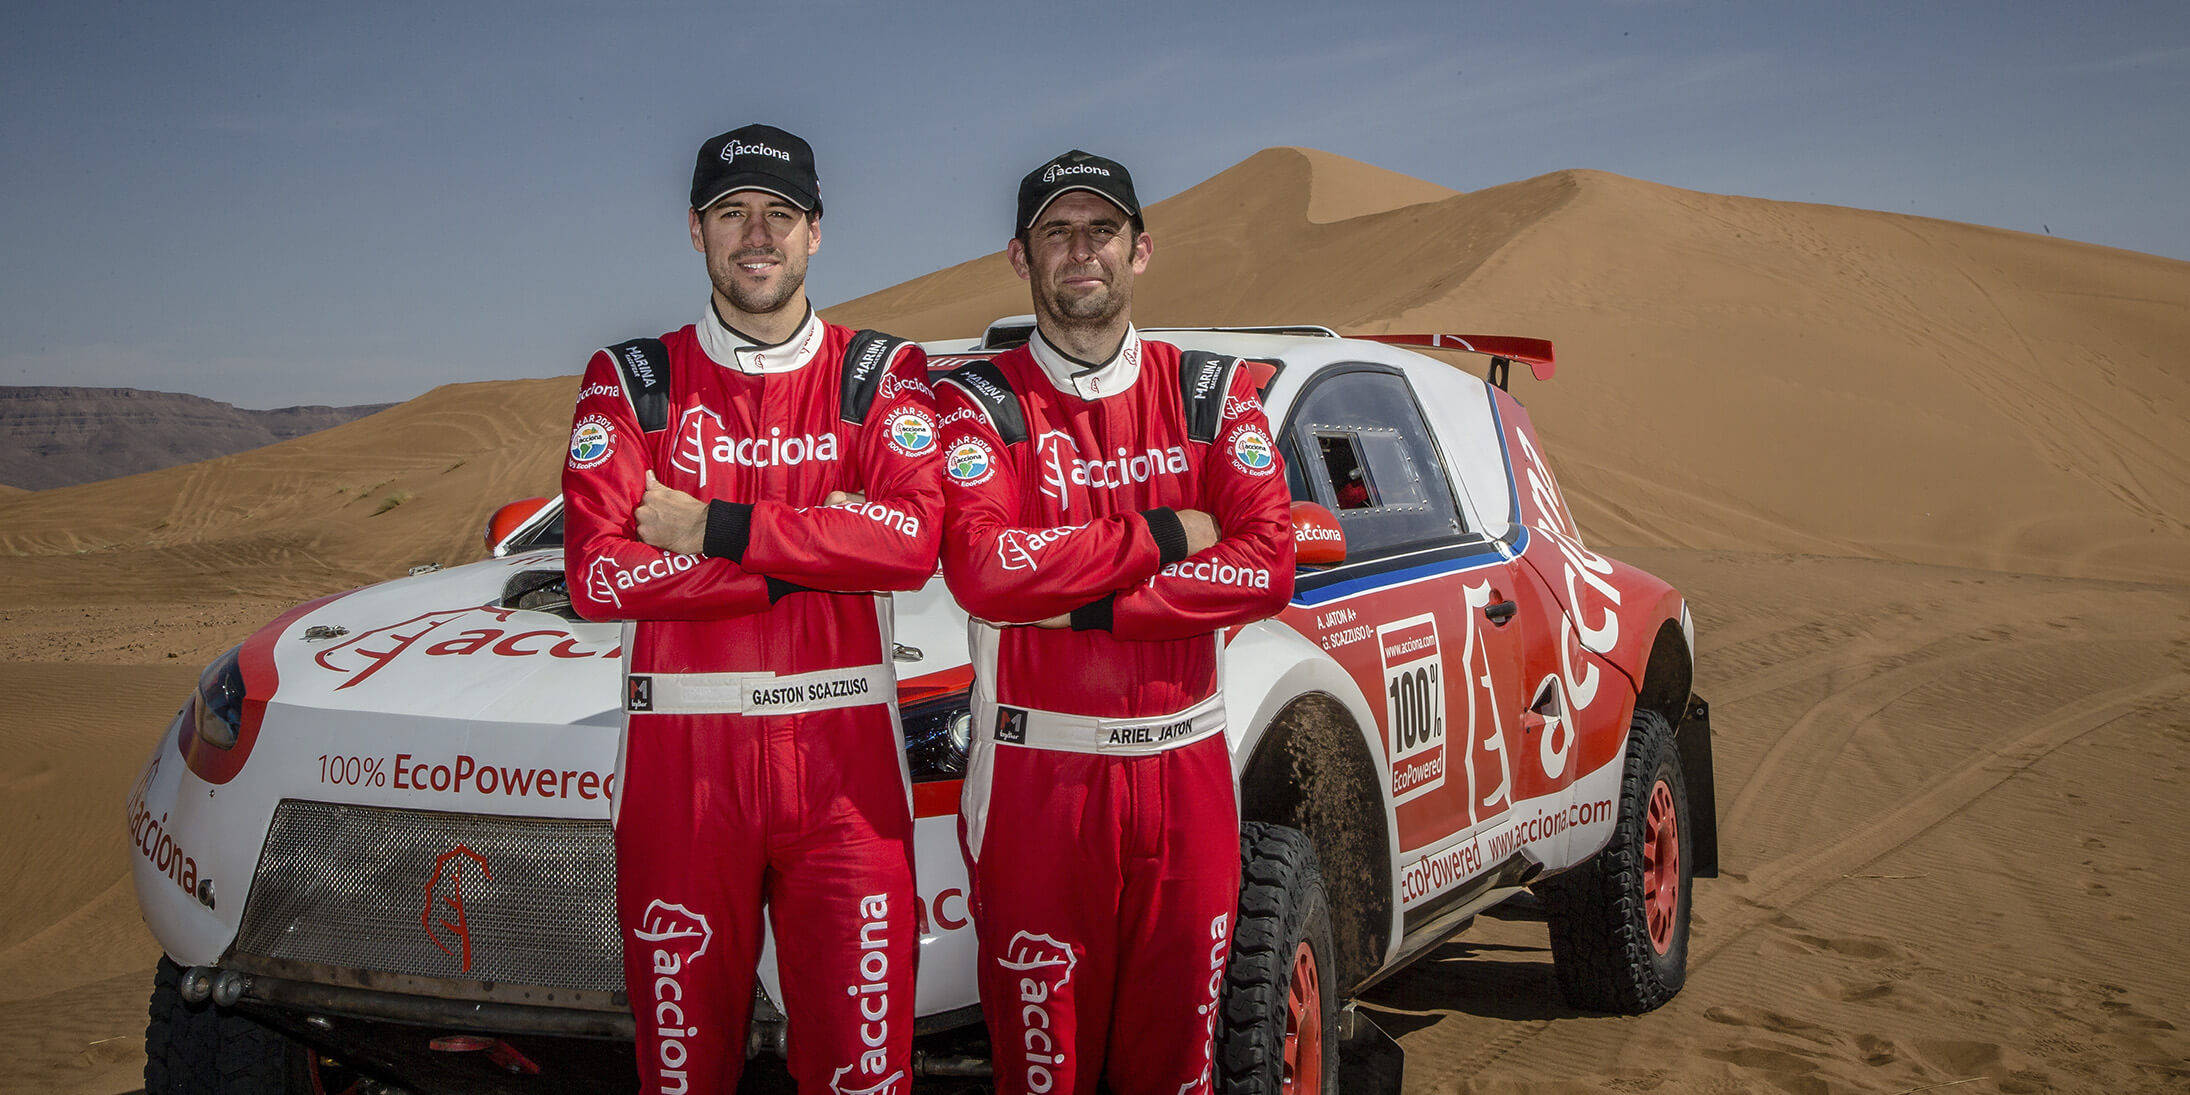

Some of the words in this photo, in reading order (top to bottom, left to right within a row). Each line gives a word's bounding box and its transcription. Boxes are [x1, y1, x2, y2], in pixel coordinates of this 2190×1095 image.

[735, 142, 790, 162] acciona
[1057, 164, 1110, 177] acciona
[625, 346, 657, 388] MARINA
[854, 339, 887, 381] MARINA
[1194, 360, 1219, 399] MARINA
[884, 406, 915, 426] DAKAR
[1228, 424, 1256, 442] DAKAR
[1071, 446, 1189, 489] acciona
[1295, 525, 1341, 542] acciona
[1161, 557, 1269, 589] acciona
[1316, 615, 1326, 630] A.
[1326, 610, 1347, 627] JATON
[1331, 625, 1365, 648] SCAZZUSO
[1385, 634, 1435, 658] www.acciona.com
[753, 687, 804, 705] GASTON
[808, 677, 869, 700] SCAZZUSO
[1390, 663, 1441, 753] 100%
[1109, 728, 1153, 744] ARIEL
[1158, 718, 1194, 741] JATON
[318, 754, 385, 787] 100%
[1394, 750, 1442, 792] EcoPowered
[1489, 799, 1612, 863] www.acciona.com
[131, 800, 197, 898] acciona
[847, 893, 888, 1075] acciona
